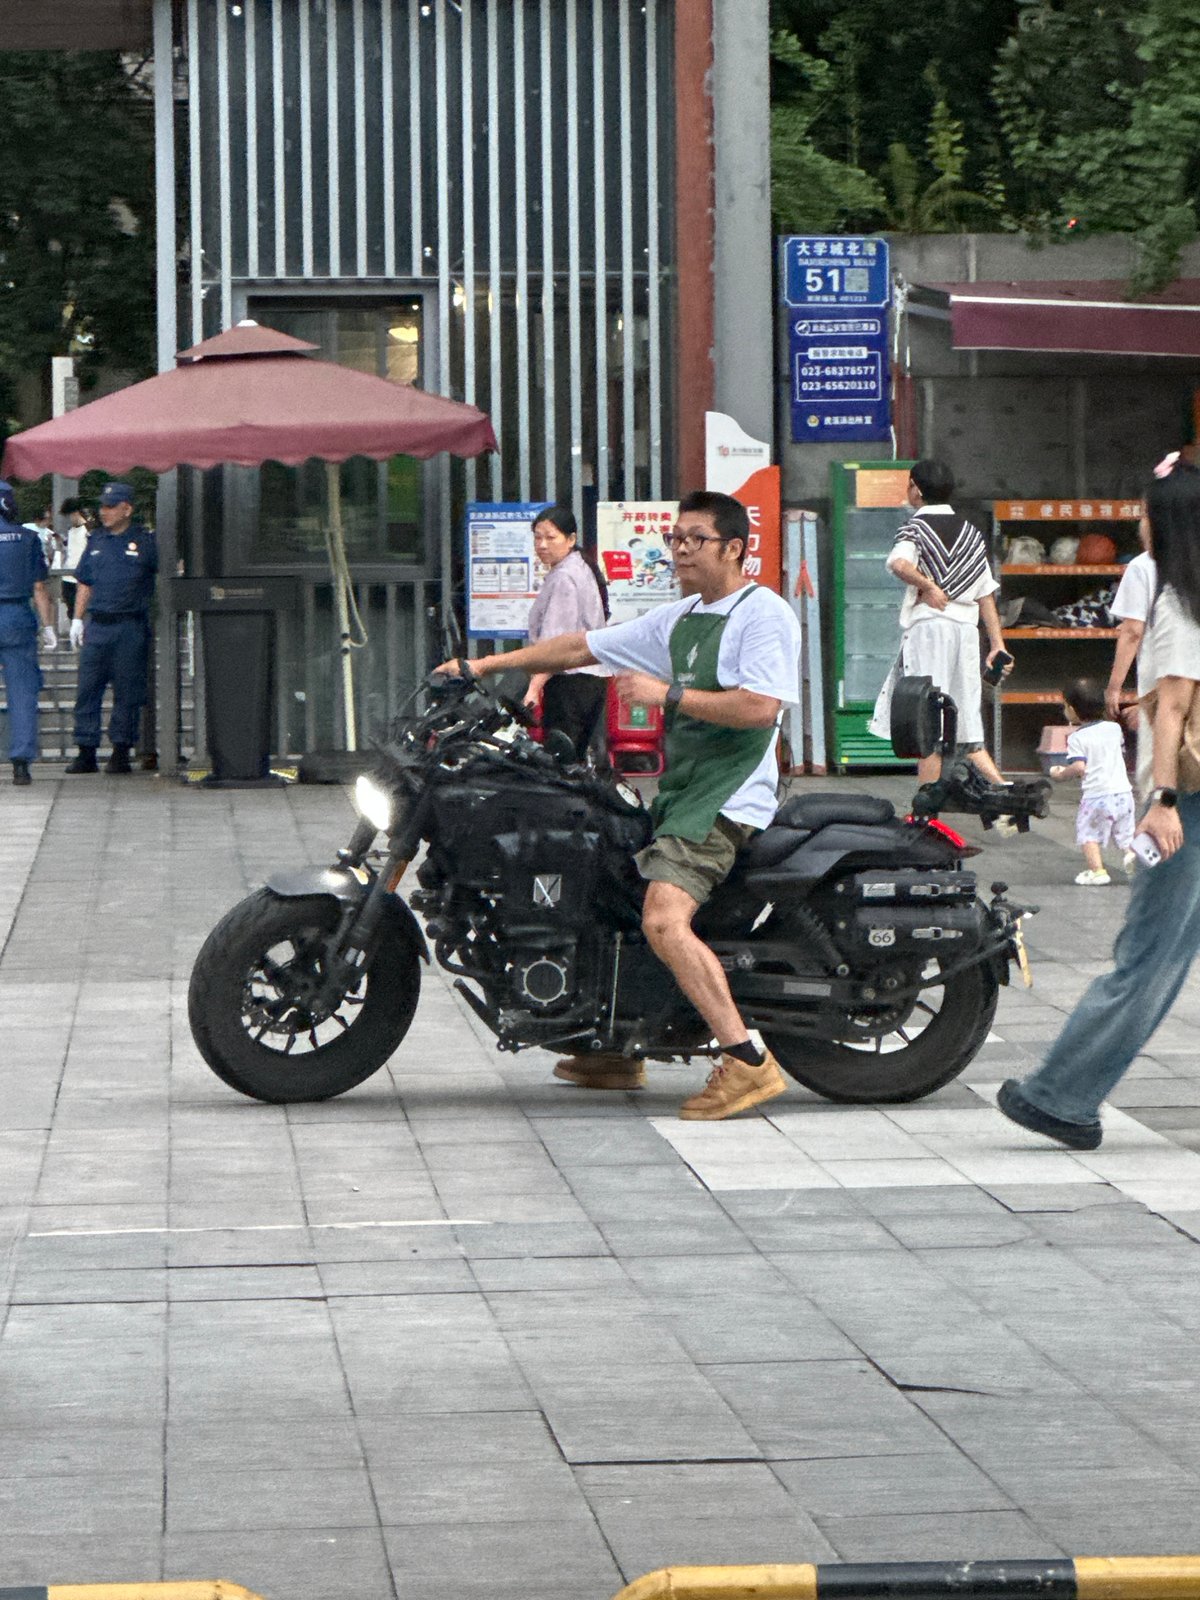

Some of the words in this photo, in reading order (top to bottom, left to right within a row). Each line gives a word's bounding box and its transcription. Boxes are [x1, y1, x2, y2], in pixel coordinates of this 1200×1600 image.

[797, 242, 876, 256] 大学城北路
[806, 269, 840, 292] 51
[872, 932, 892, 944] 66
